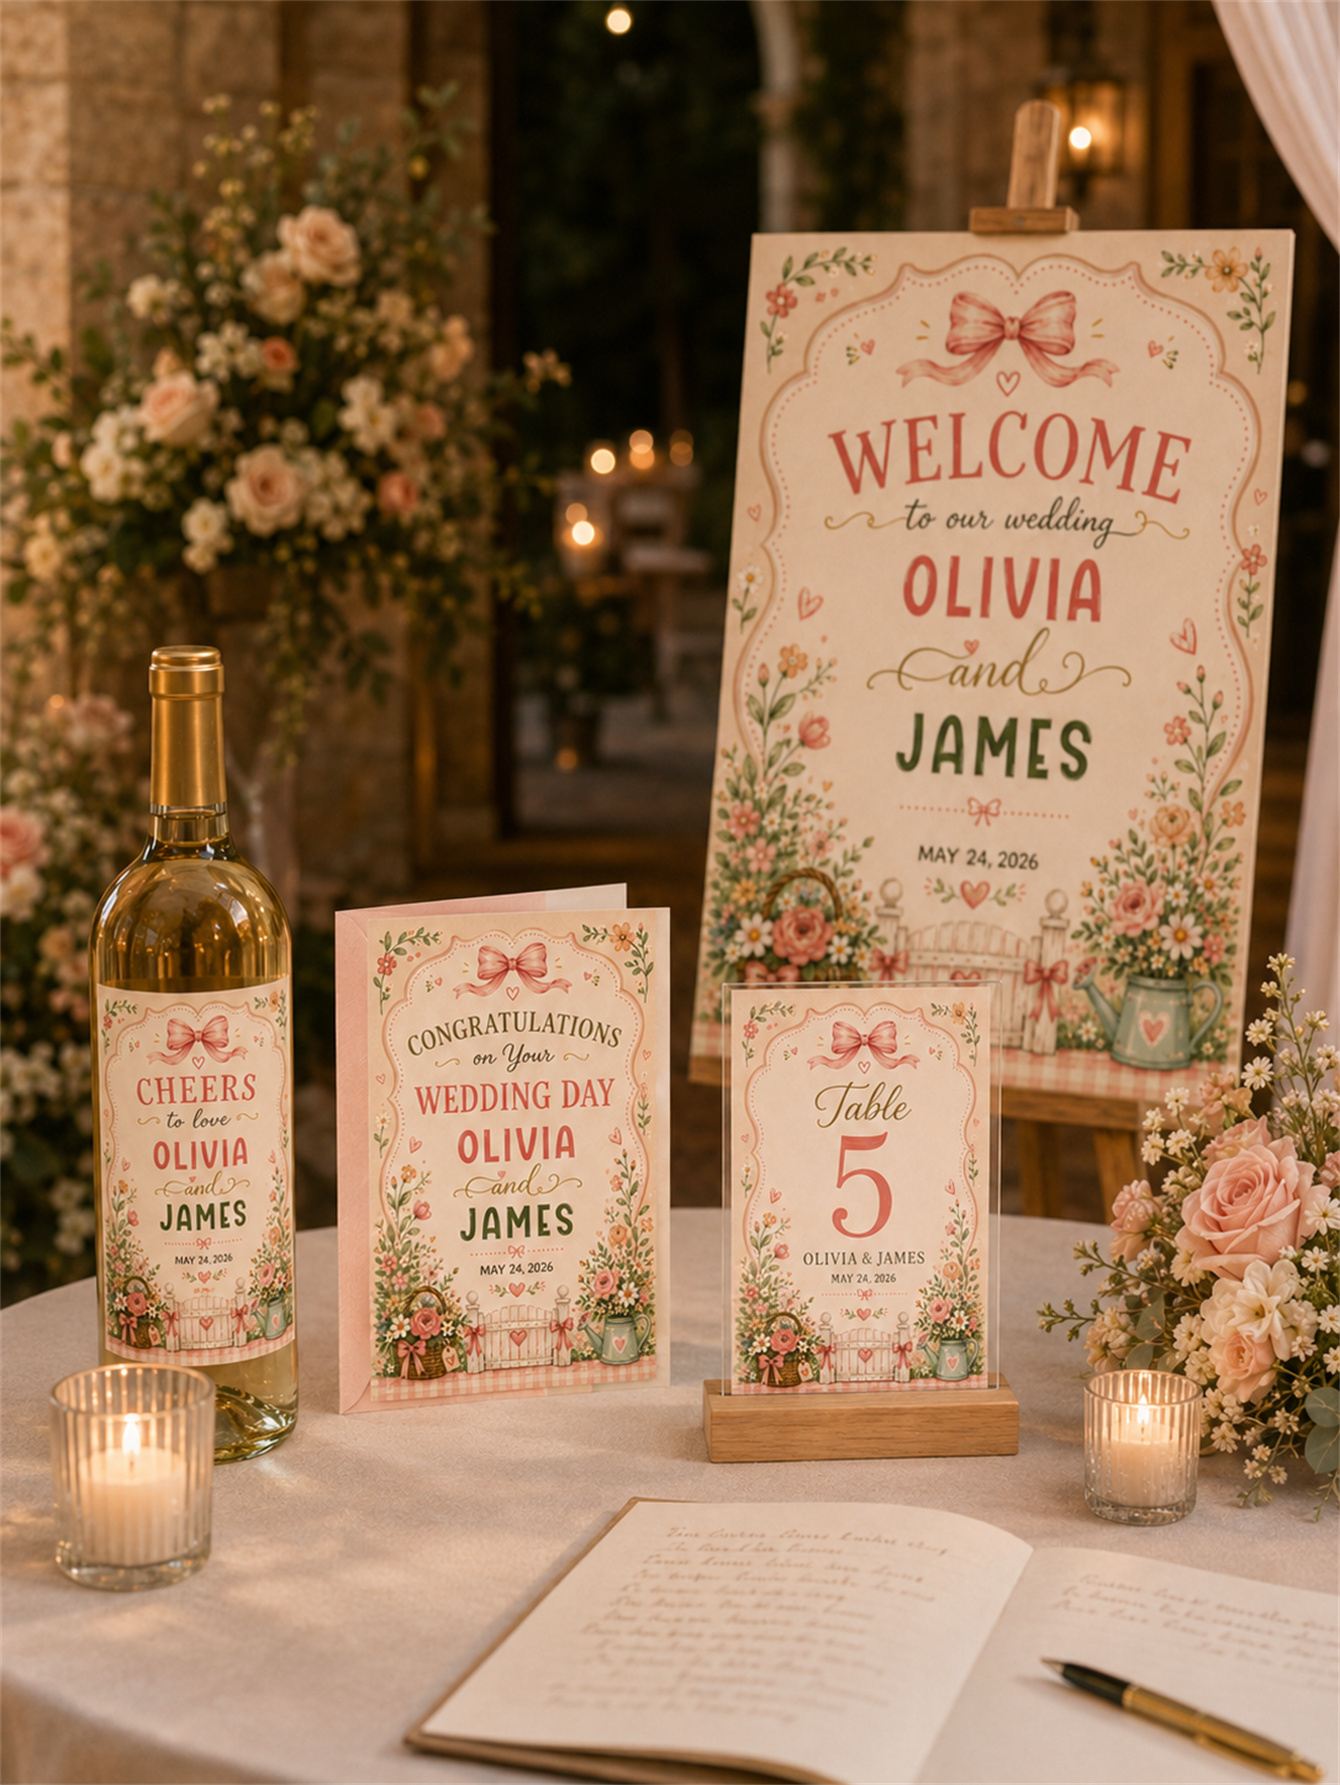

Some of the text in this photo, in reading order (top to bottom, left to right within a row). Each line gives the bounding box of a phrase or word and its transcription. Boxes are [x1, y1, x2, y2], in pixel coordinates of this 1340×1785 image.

[828, 410, 1192, 504] WELCOME
[904, 496, 1118, 549] to our wedding
[902, 554, 1102, 622] OLIVIA
[940, 627, 1085, 695] and
[896, 712, 1092, 781] JAMES
[917, 845, 1039, 870] MAY 24, 2026
[407, 1011, 622, 1056] CONGRATULATIONS
[473, 1043, 555, 1072] on Your
[136, 1073, 257, 1106] CHEERS
[414, 1078, 615, 1115] WEDDING DAY
[814, 1081, 912, 1128] Table
[167, 1108, 231, 1129] to love
[153, 1137, 248, 1170] OLIVIA
[457, 1125, 575, 1164] OLIVIA
[180, 1170, 237, 1197] and
[487, 1163, 562, 1196] and
[831, 1131, 893, 1238] 5
[160, 1199, 247, 1231] JAMES
[460, 1203, 574, 1241] JAMES
[174, 1255, 196, 1265] MAY
[213, 1253, 233, 1264] 2026
[480, 1261, 553, 1275] MAY 24, 2026
[803, 1251, 925, 1266] OLIVIA & JAMES
[831, 1273, 853, 1284] MAY
[874, 1273, 897, 1283] 2026
